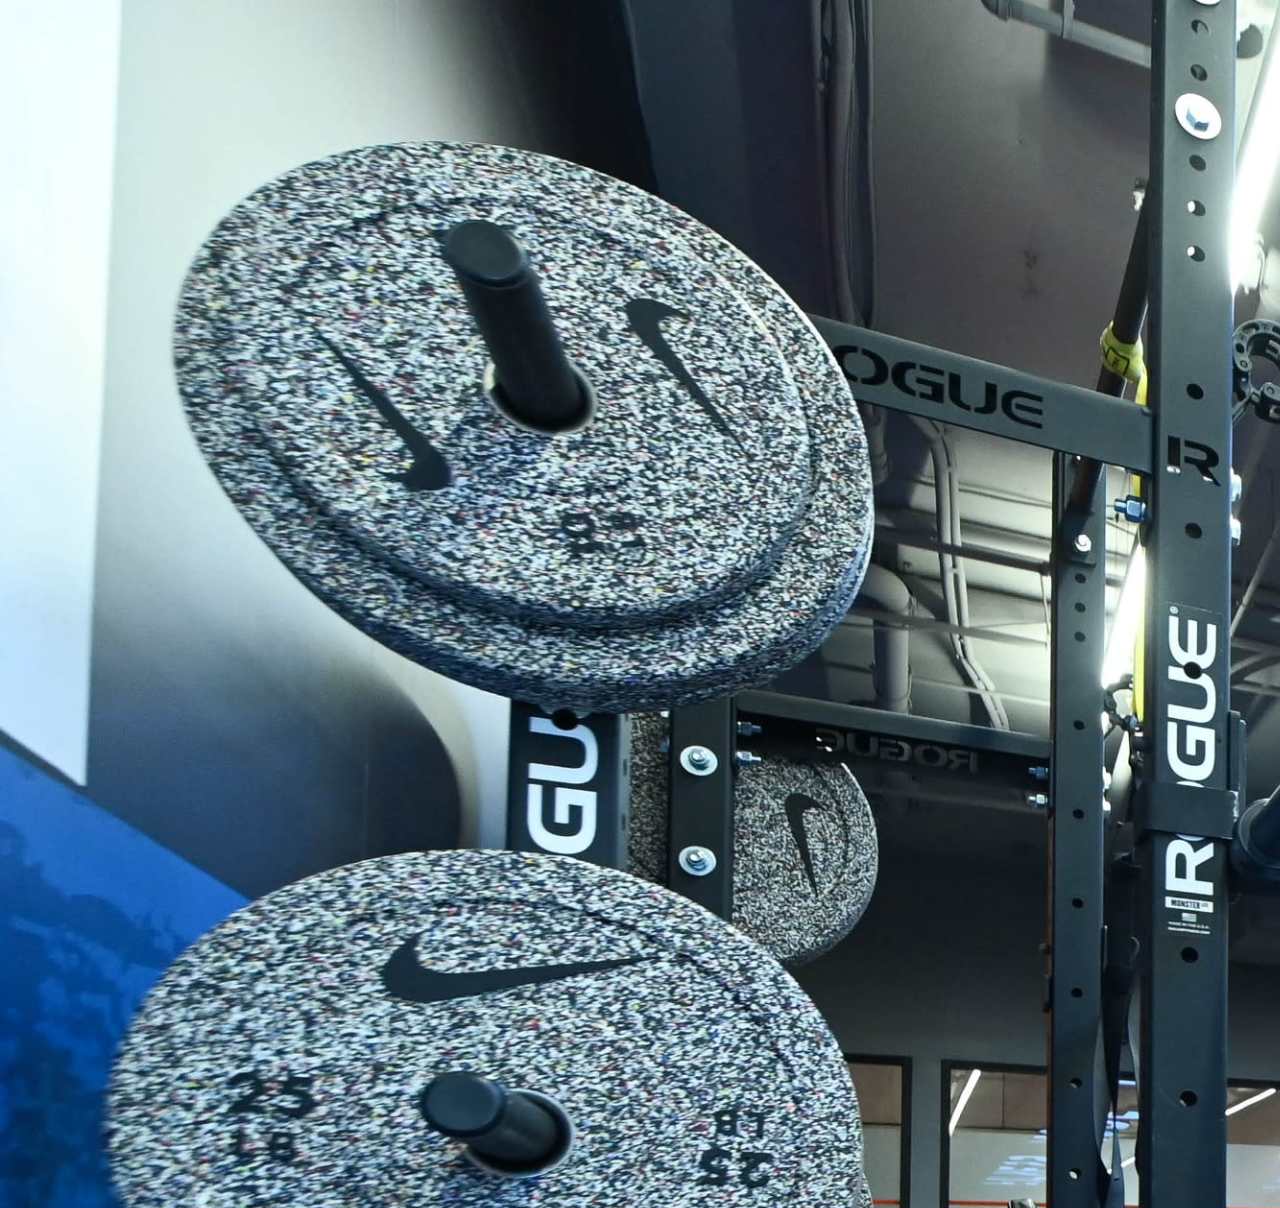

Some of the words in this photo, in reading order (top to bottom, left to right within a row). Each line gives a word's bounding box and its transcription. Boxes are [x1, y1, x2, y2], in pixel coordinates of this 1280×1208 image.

[835, 345, 1043, 429] OGUE
[1165, 605, 1217, 896] RGUE
[527, 716, 598, 855] GU
[227, 1073, 317, 1116] 25
[711, 1106, 769, 1137] LB
[698, 1150, 772, 1189] 25
